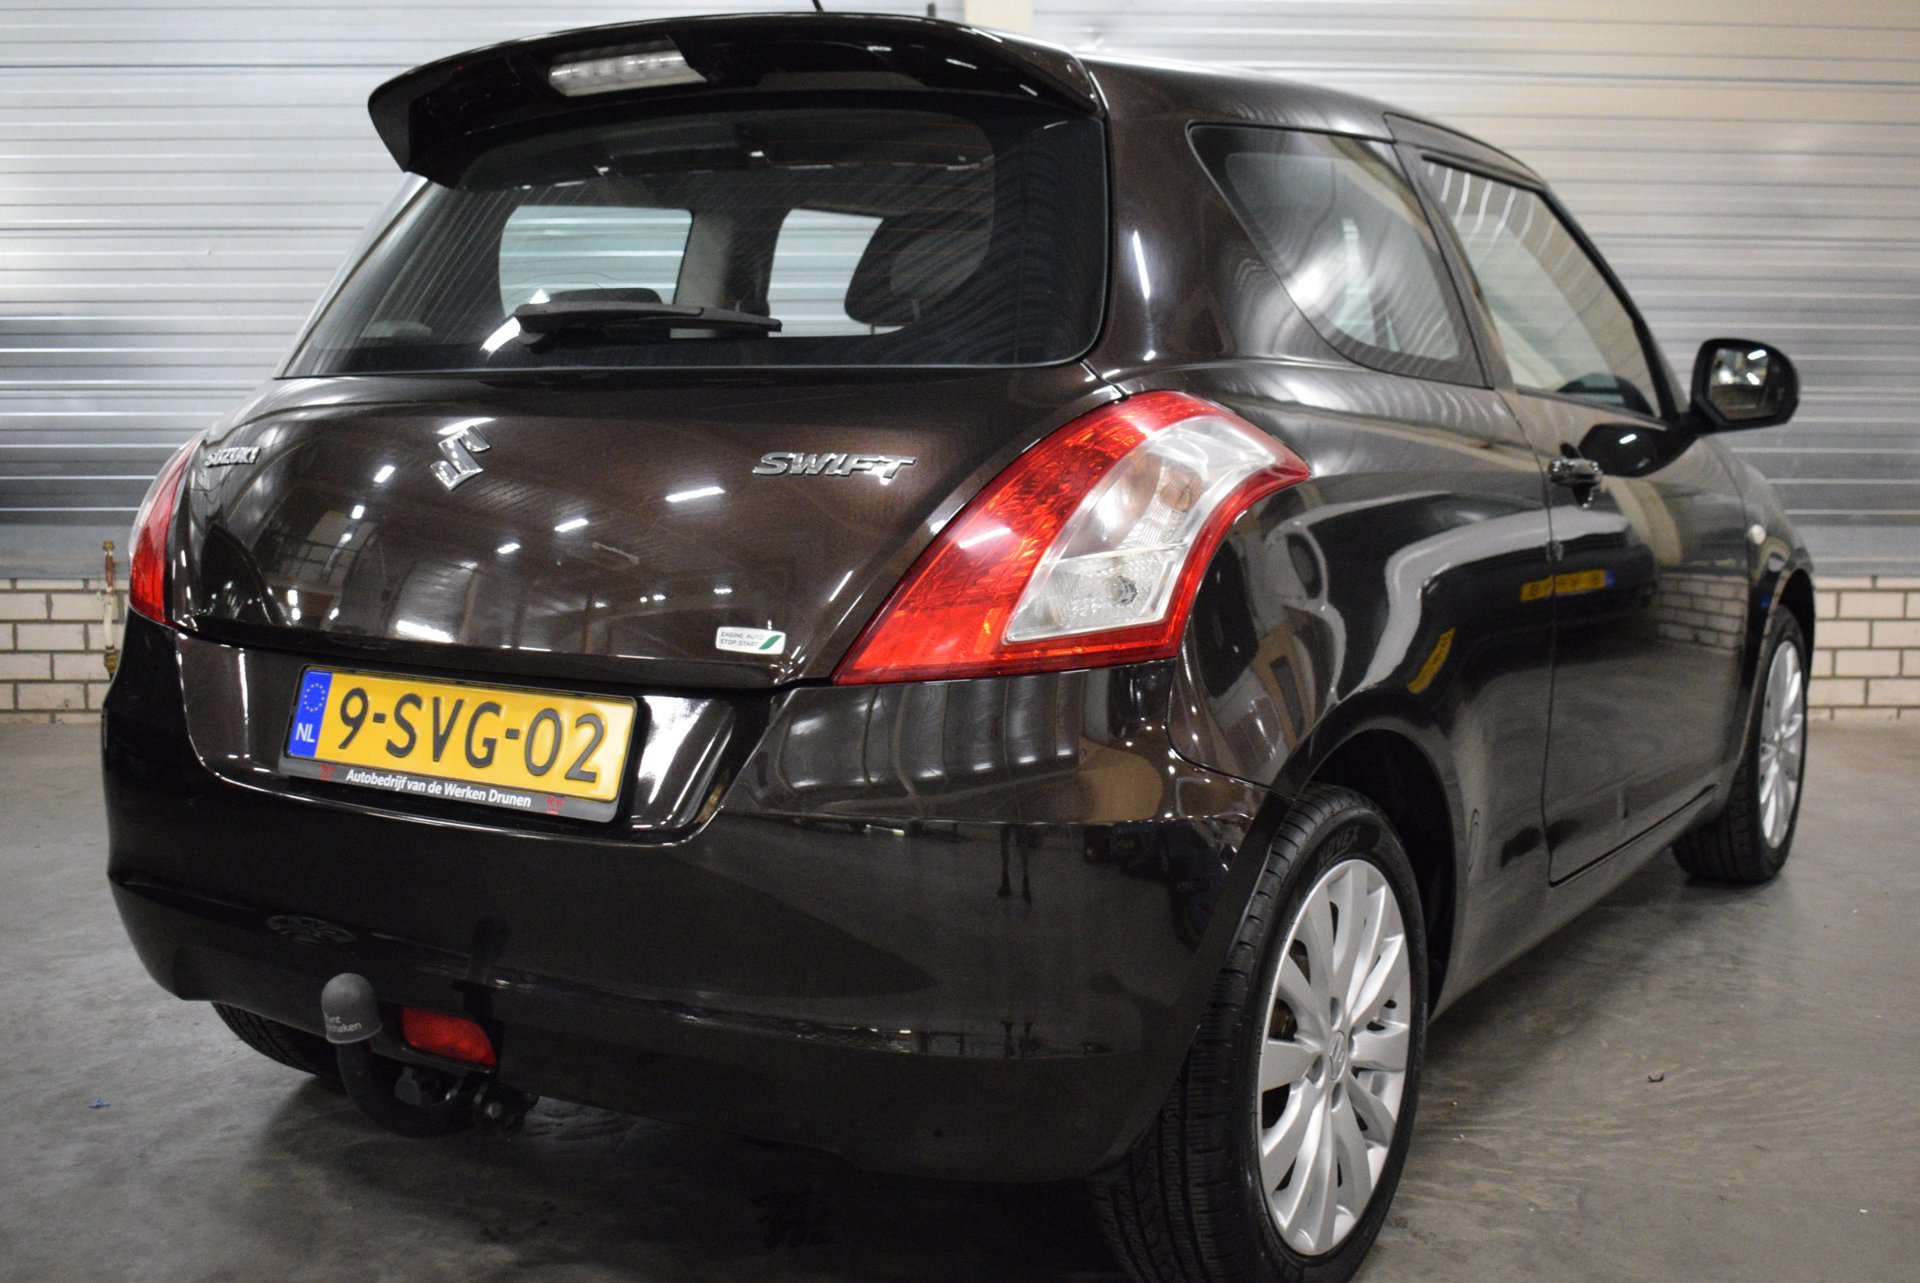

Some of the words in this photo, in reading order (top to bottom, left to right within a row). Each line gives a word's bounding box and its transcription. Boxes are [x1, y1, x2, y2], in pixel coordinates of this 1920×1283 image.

[204, 446, 260, 468] SUZUKI
[752, 452, 917, 479] SWIFT
[720, 631, 744, 639] ENGINE
[295, 722, 316, 743] NL
[338, 687, 608, 784] 9-SVG-02
[345, 769, 408, 791] Autobedrijf
[407, 780, 426, 793] van
[427, 781, 442, 795] de
[444, 783, 486, 801] Werken
[488, 789, 532, 808] Drunen
